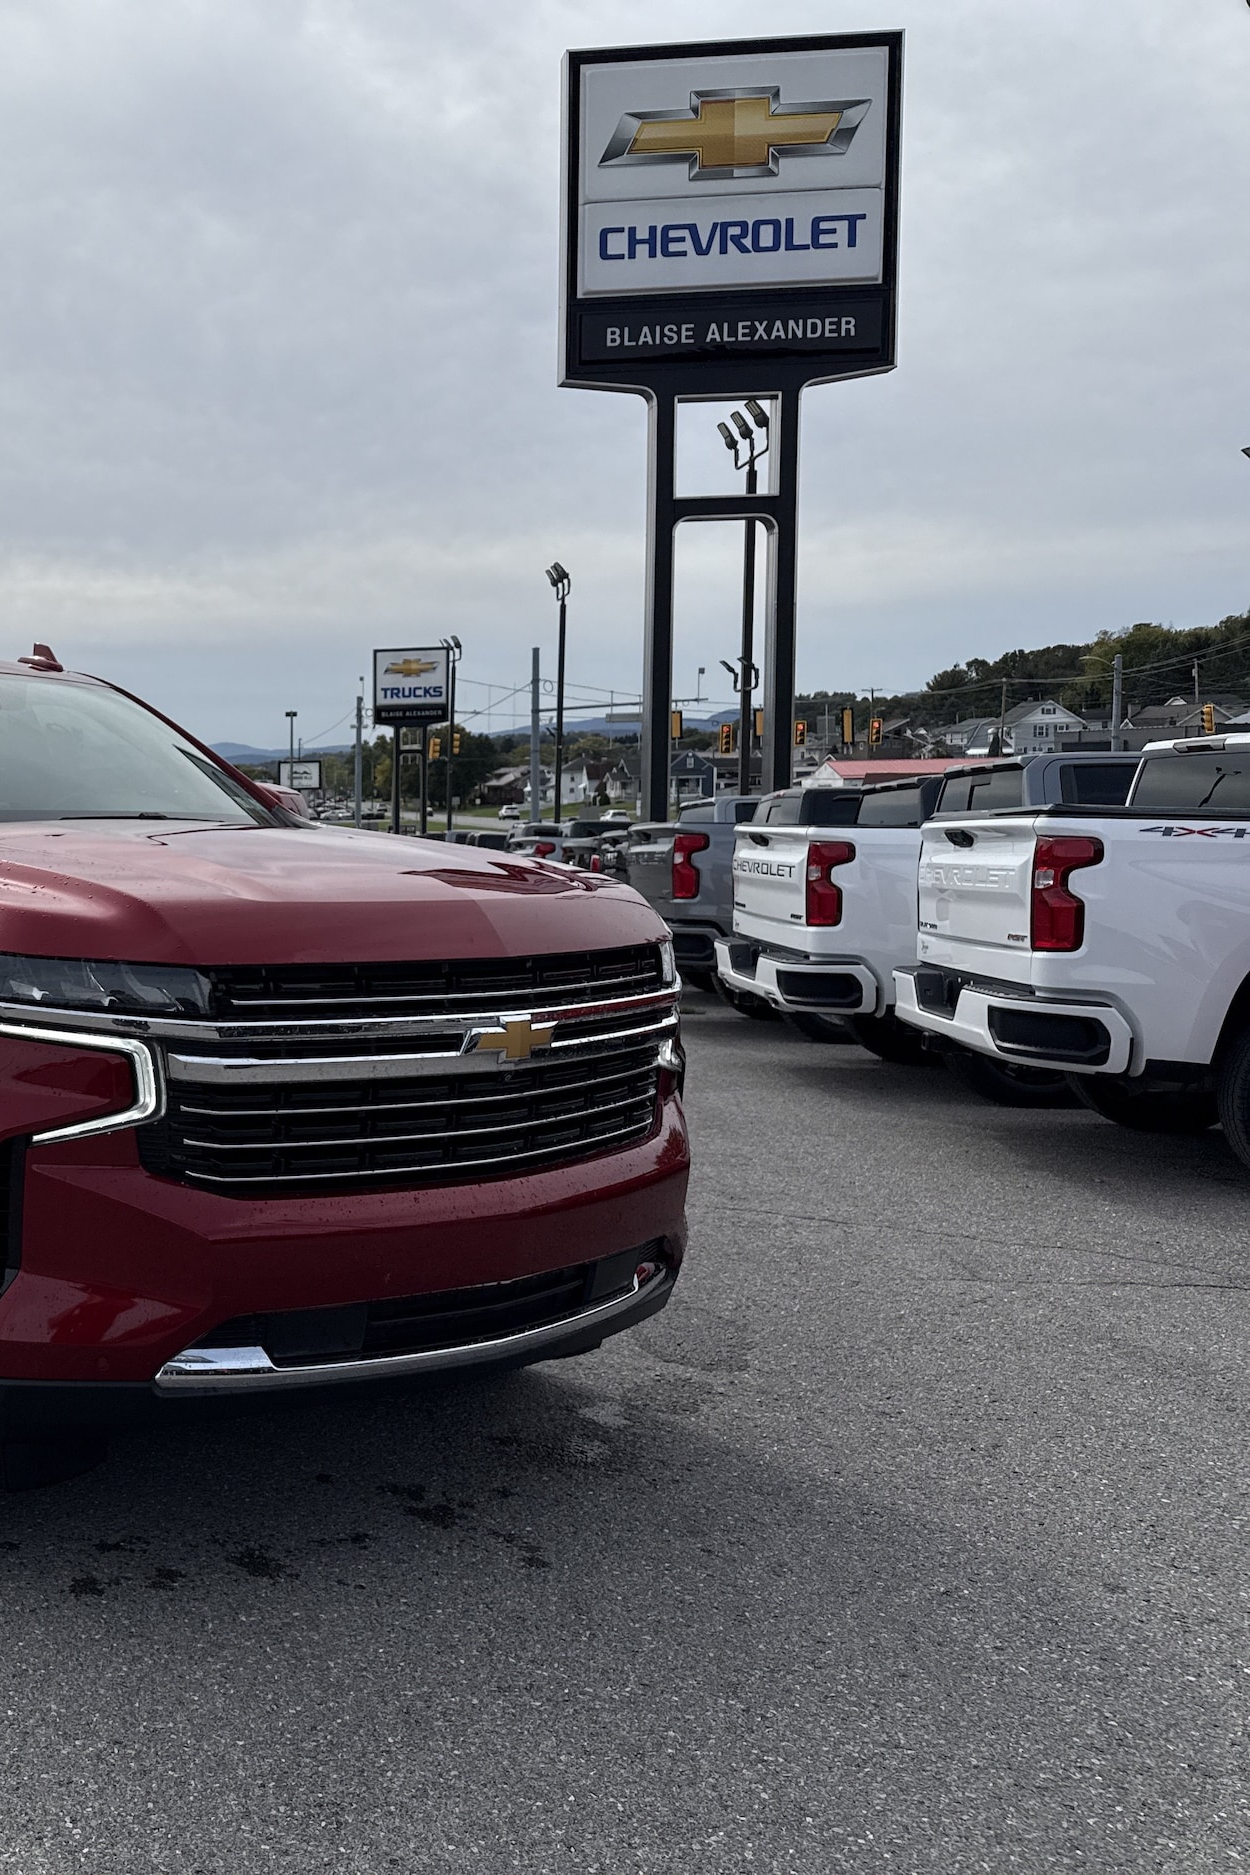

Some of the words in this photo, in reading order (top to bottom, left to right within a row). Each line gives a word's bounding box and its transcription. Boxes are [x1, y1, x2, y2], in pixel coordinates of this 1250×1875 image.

[599, 213, 867, 261] CHEVROLET
[606, 323, 695, 347] BLAISE
[705, 316, 856, 343] ALEXANDER
[381, 686, 443, 699] TRUCKS
[733, 859, 796, 878] CHEVROLET
